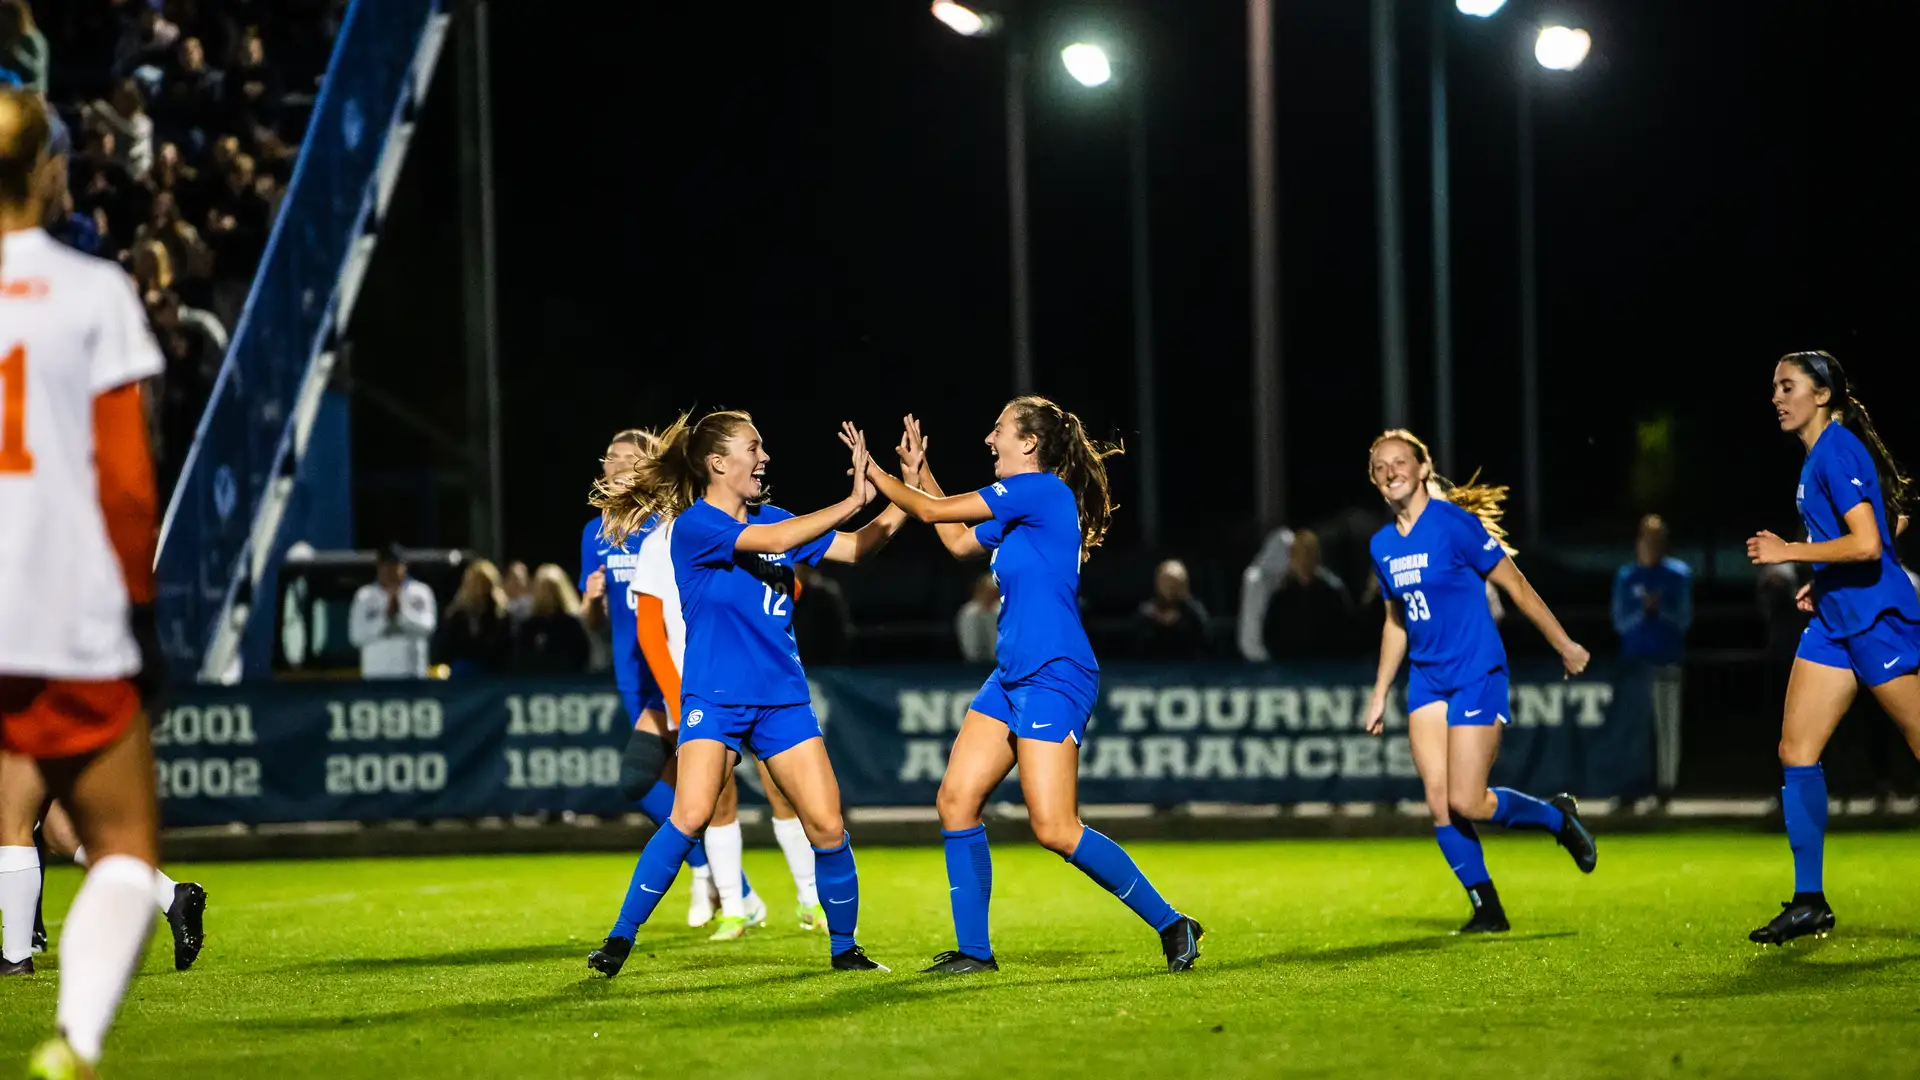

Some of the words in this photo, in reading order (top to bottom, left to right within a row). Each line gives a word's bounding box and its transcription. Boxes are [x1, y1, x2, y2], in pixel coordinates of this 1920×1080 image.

[762, 581, 788, 616] 12
[1402, 590, 1431, 622] 33
[327, 698, 444, 741] 1999
[505, 693, 619, 735] 1997
[1108, 684, 1613, 732] TOURNANT
[325, 753, 448, 794] 2000
[506, 747, 621, 789] 1998
